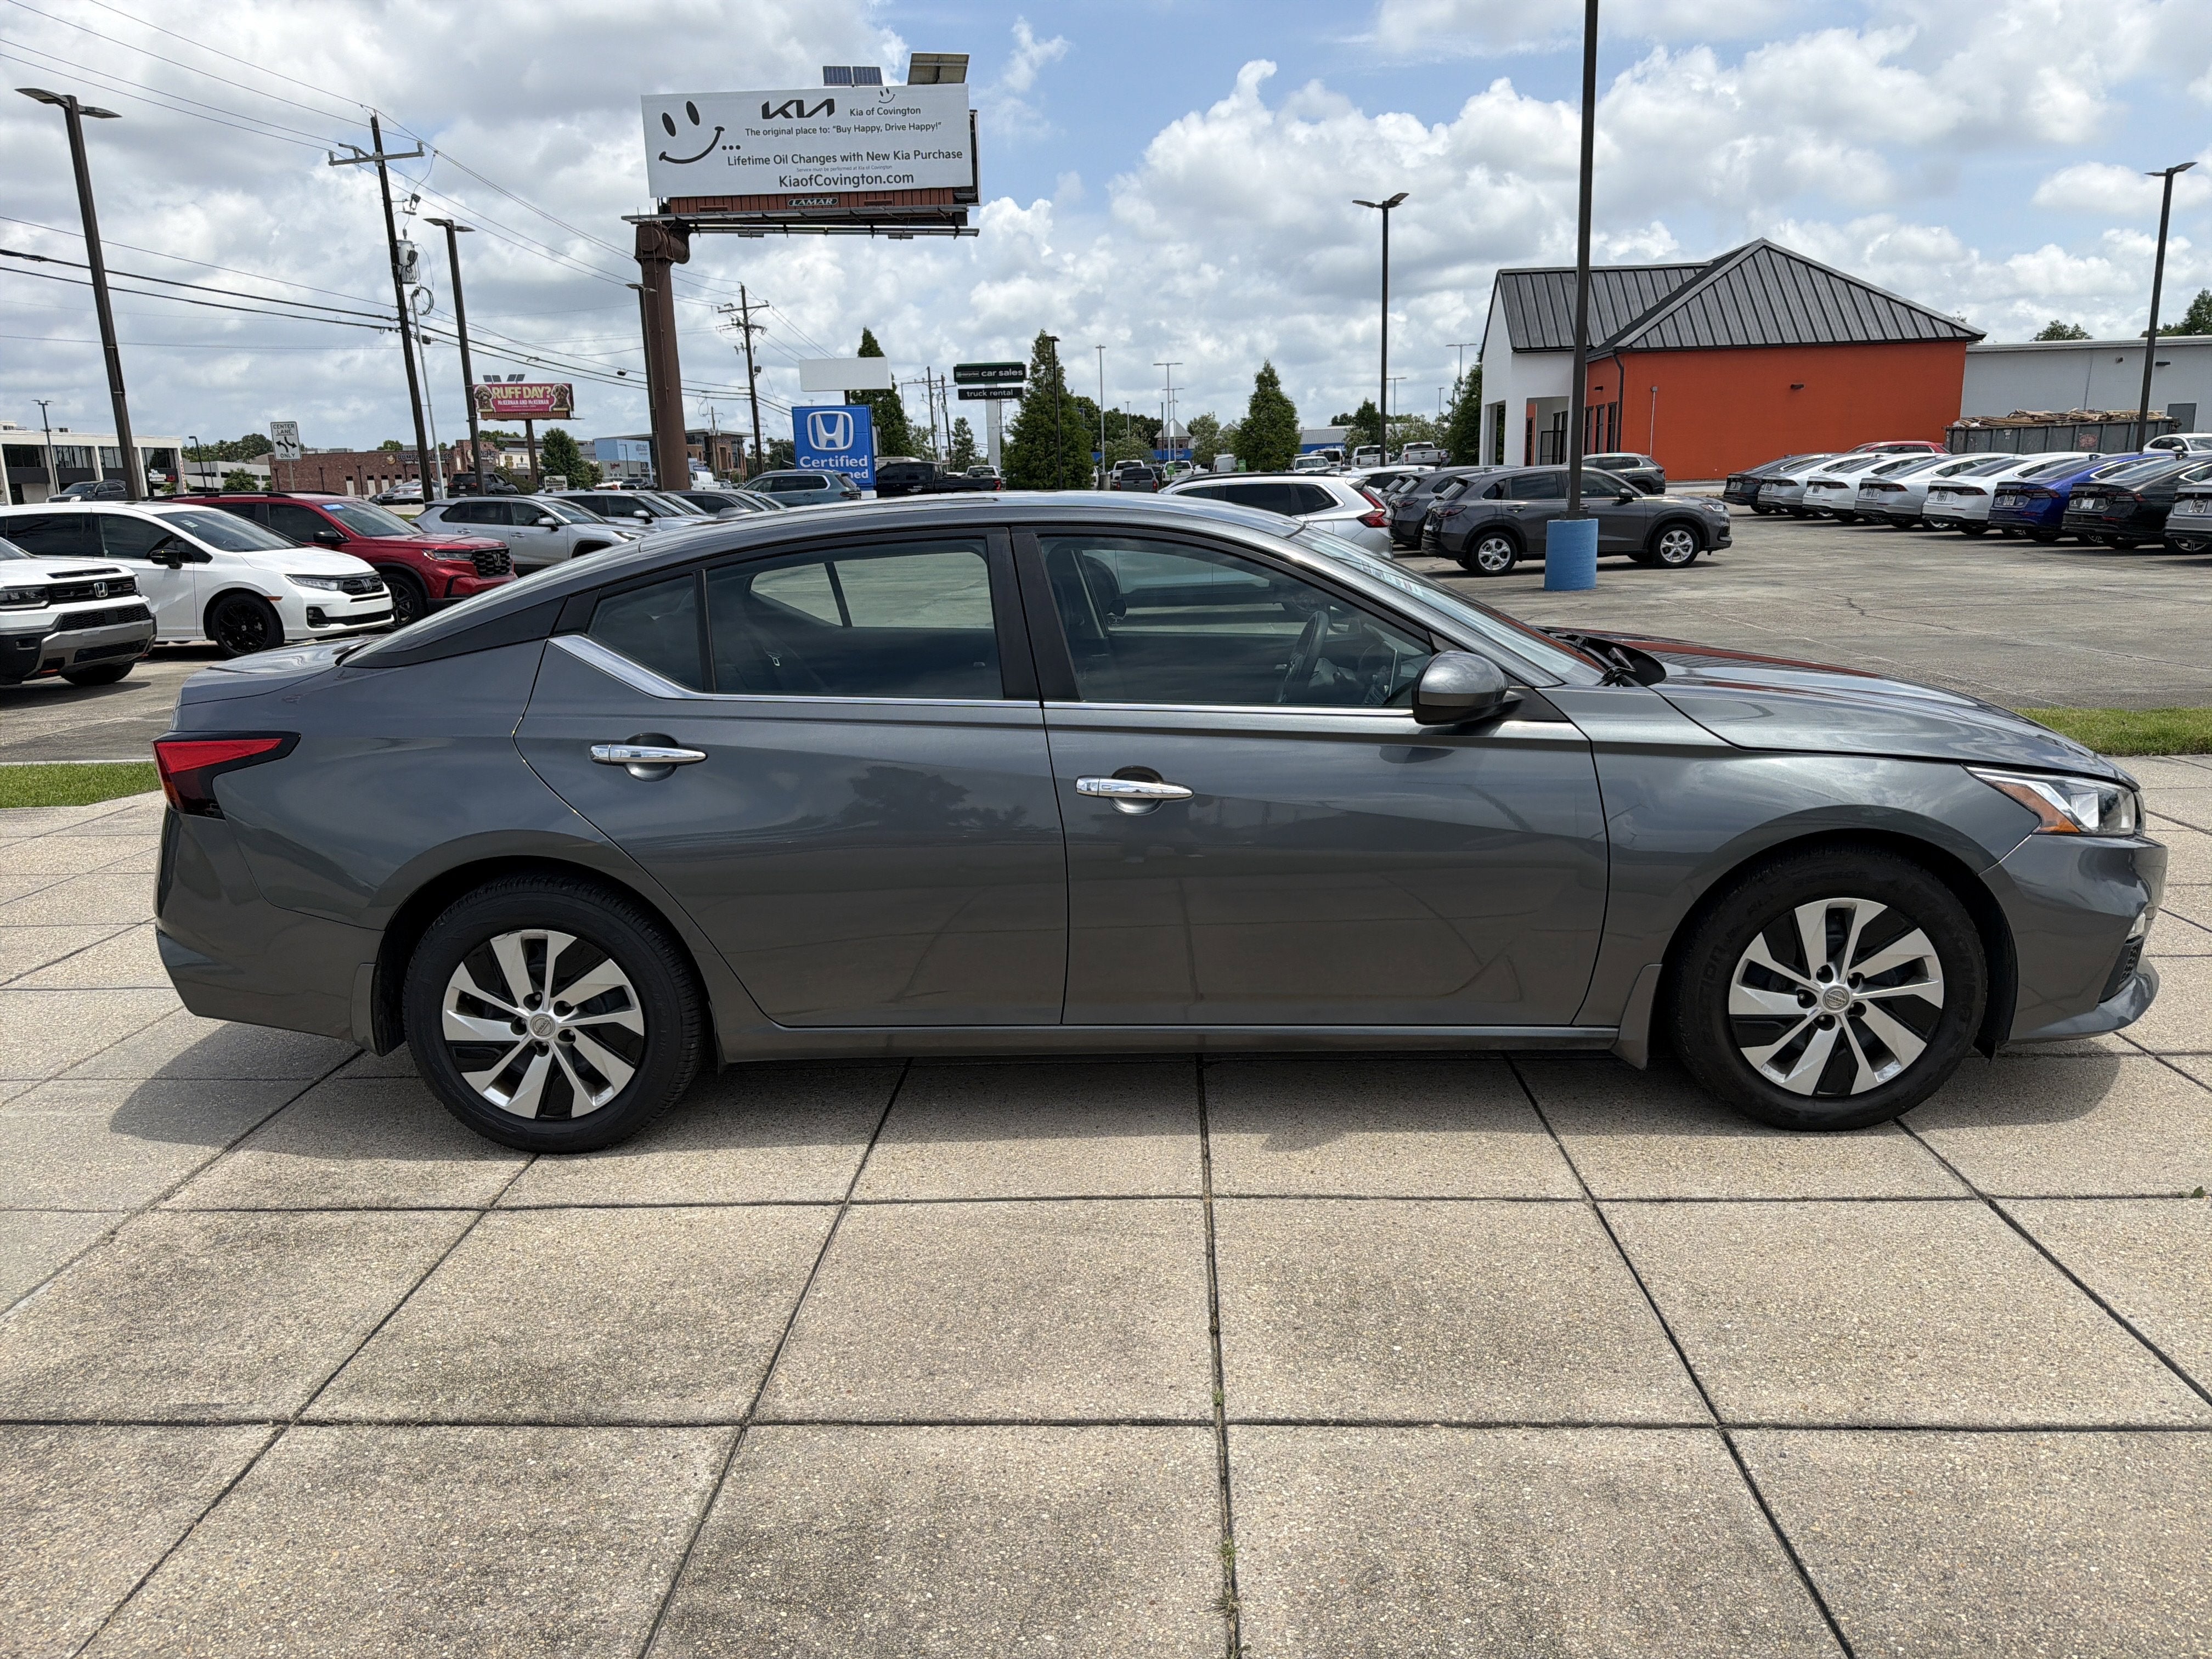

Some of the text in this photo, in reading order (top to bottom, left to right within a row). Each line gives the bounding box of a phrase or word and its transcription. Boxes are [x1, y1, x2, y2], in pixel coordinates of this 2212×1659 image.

[761, 99, 835, 120] KIA
[850, 106, 921, 117] Kia of Covington
[745, 128, 760, 136] The
[763, 127, 793, 137] original
[795, 126, 817, 137] place
[819, 126, 831, 134] to:
[854, 124, 883, 134] Happy,
[885, 122, 906, 132] Drive
[727, 149, 963, 166] Lifetime Oil Changes with New Kia Purchase
[779, 173, 915, 188] KiaofCovington.com
[998, 368, 1023, 376] sales
[492, 386, 551, 399] RUFF DAY?
[799, 455, 868, 467] Certified
[1827, 994, 1846, 1003] NISSAN
